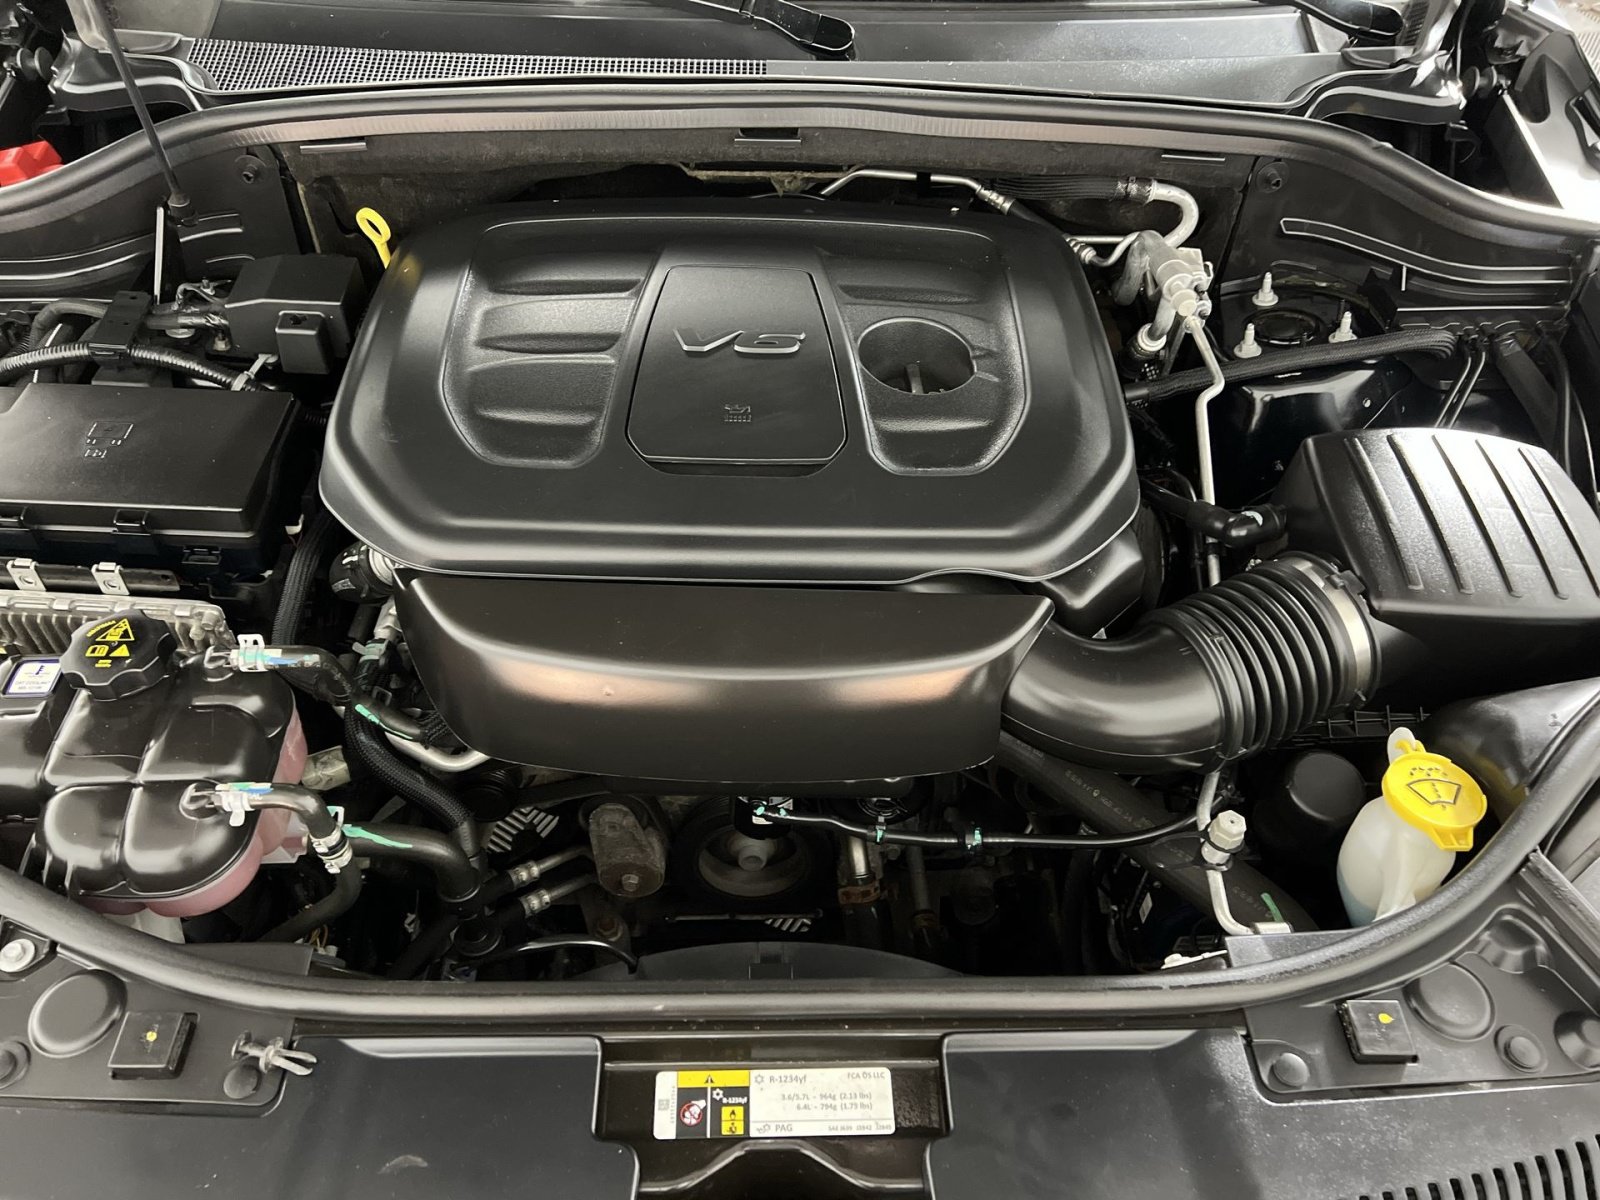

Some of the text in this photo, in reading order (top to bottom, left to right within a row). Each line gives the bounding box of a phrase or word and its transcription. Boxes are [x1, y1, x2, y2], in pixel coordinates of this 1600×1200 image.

[673, 327, 807, 355] V6
[769, 1074, 807, 1084] R-1234yf
[775, 1123, 793, 1132] PAG
